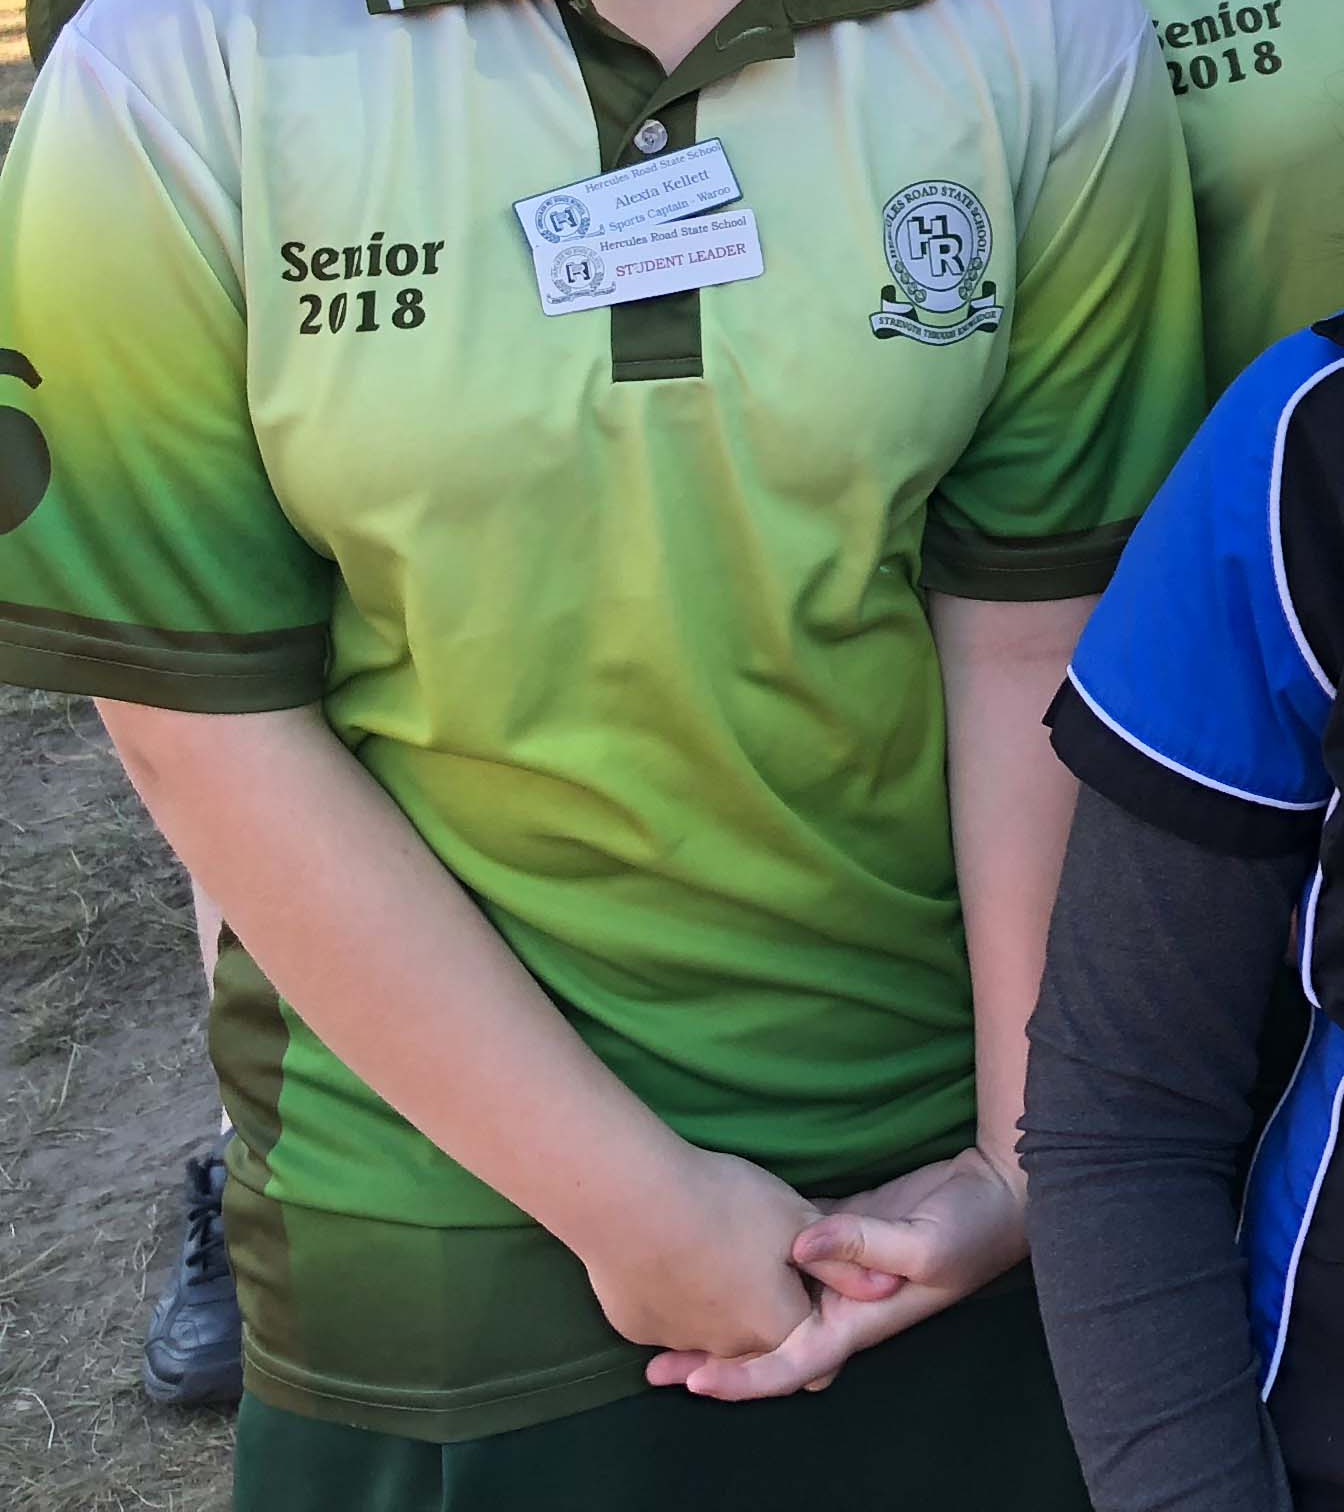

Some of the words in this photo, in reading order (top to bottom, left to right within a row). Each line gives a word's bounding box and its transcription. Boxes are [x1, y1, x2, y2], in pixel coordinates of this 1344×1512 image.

[1152, 0, 1282, 50] enior
[1167, 41, 1282, 97] 2018
[584, 173, 630, 194] Hercules
[631, 162, 658, 178] Road
[660, 155, 687, 169] State
[686, 142, 721, 161] School
[662, 169, 711, 193] Kellett
[600, 236, 649, 252] Hercules
[650, 230, 679, 243] Road
[681, 223, 709, 236] State
[711, 215, 748, 231] School
[608, 214, 646, 233] Sports
[647, 199, 690, 220] Captain
[904, 185, 939, 204] ROAD
[940, 185, 975, 210] STATE
[970, 205, 987, 258] SCHOOL
[280, 232, 445, 282] Senior
[688, 243, 747, 265] LEADER
[906, 214, 966, 277] HR
[299, 287, 426, 335] 2018
